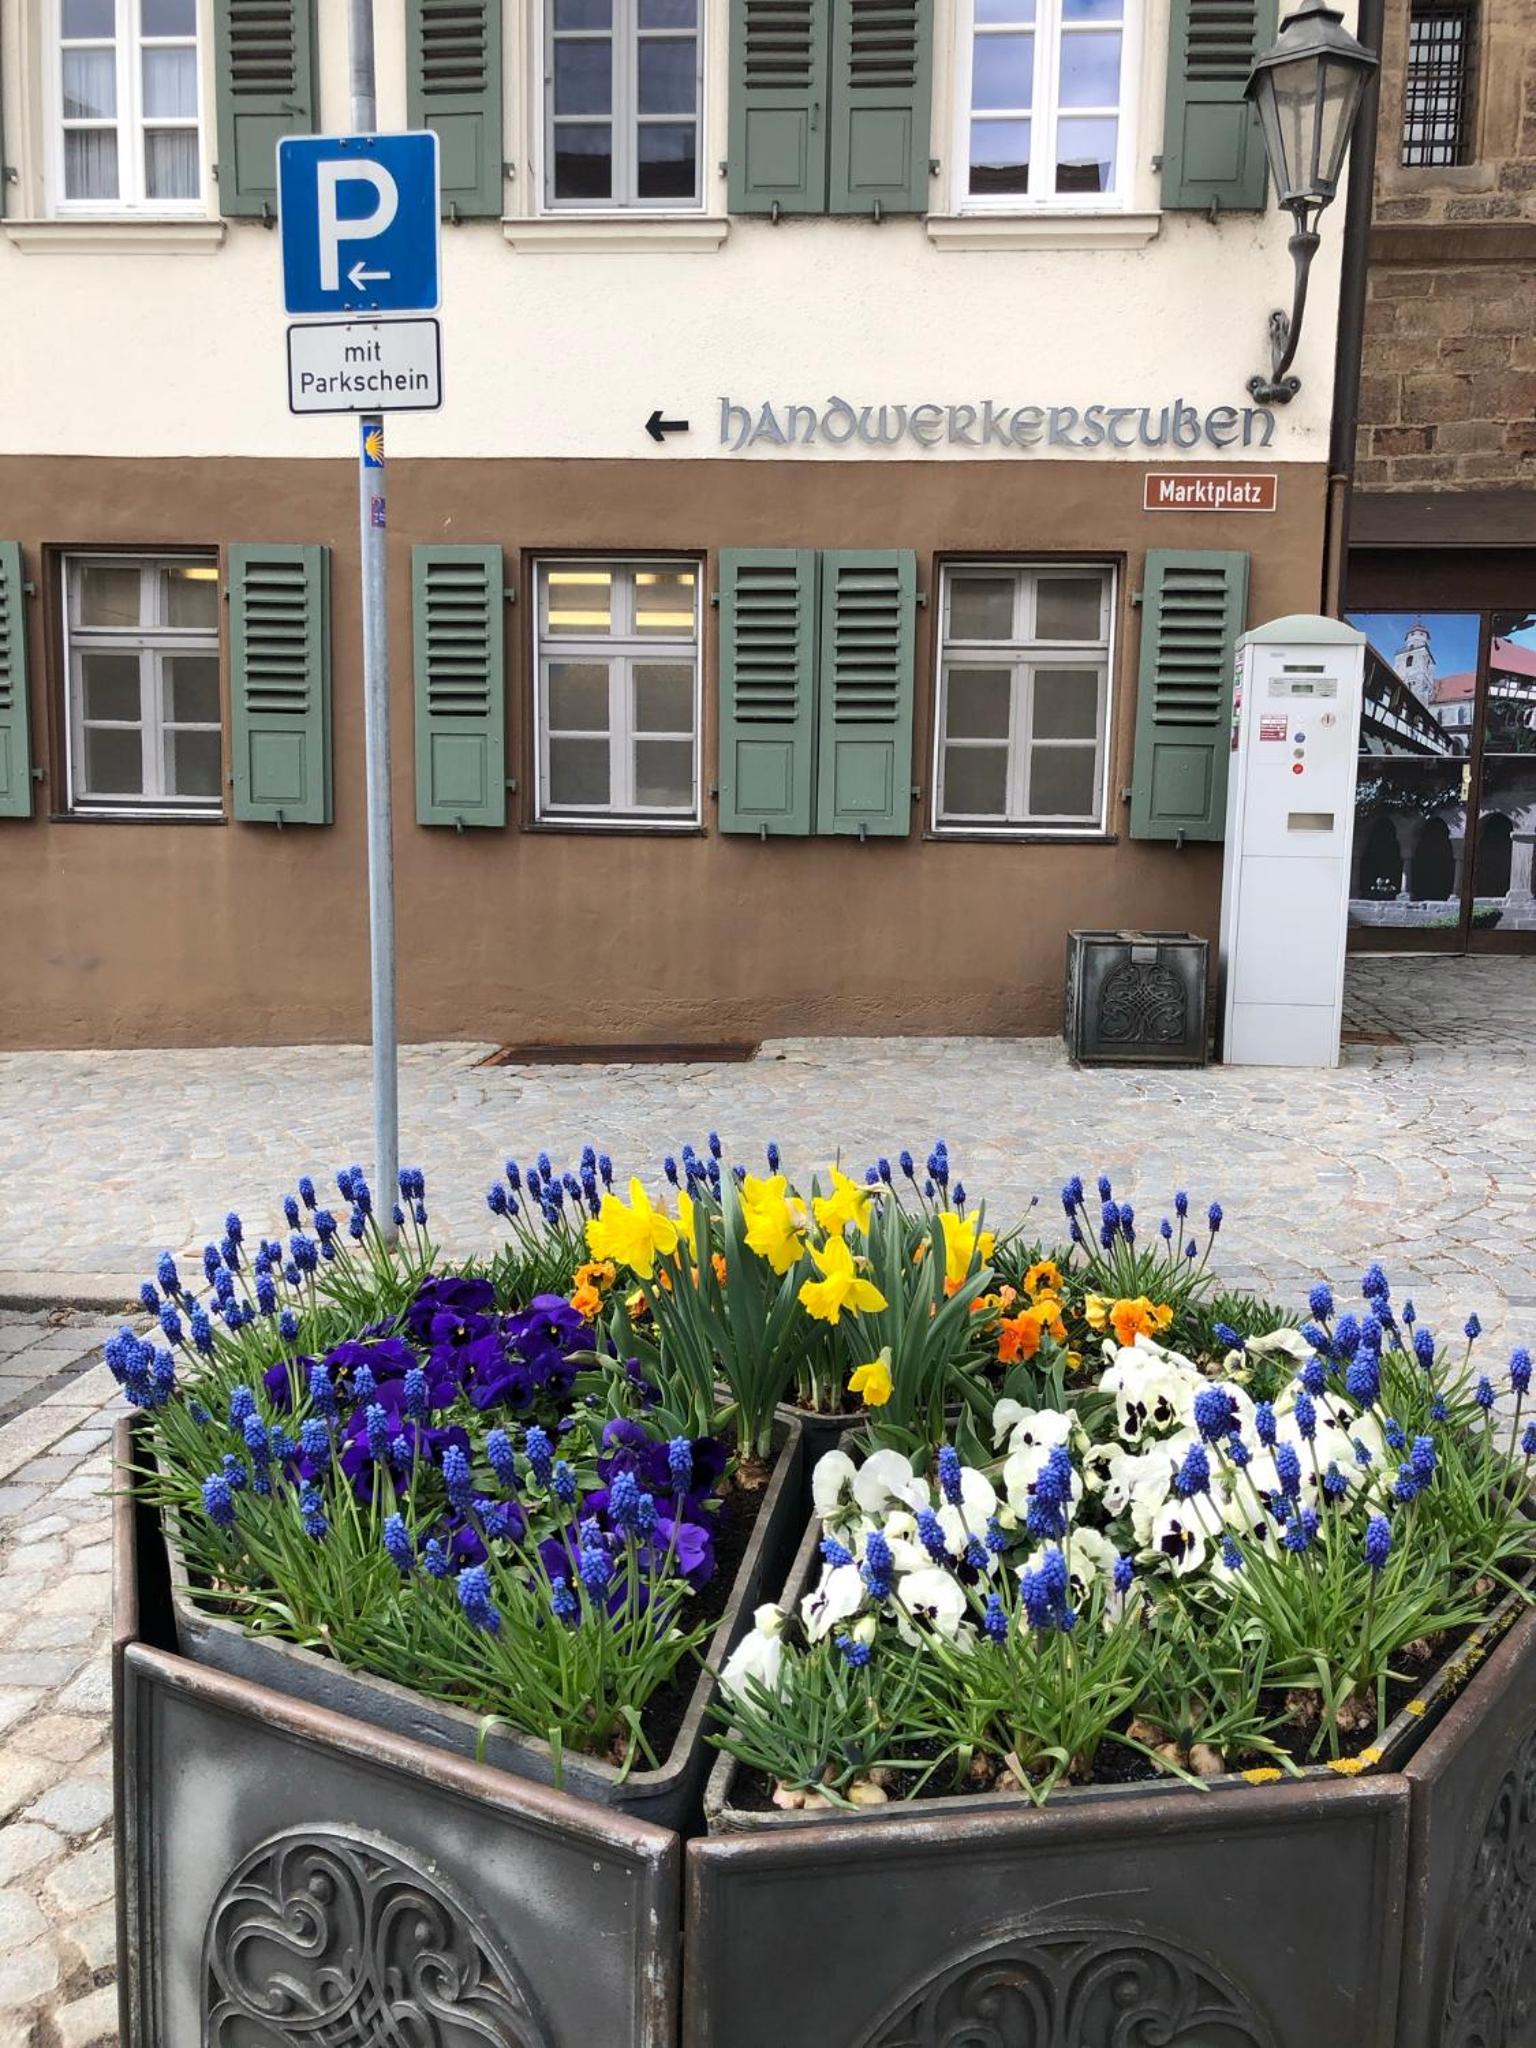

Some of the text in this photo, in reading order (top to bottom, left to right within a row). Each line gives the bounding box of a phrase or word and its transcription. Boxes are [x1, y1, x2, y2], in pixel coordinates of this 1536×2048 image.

[317, 159, 399, 291] P
[344, 340, 382, 362] mit
[300, 368, 429, 394] Parkschein
[1159, 480, 1262, 508] Marktplatz
